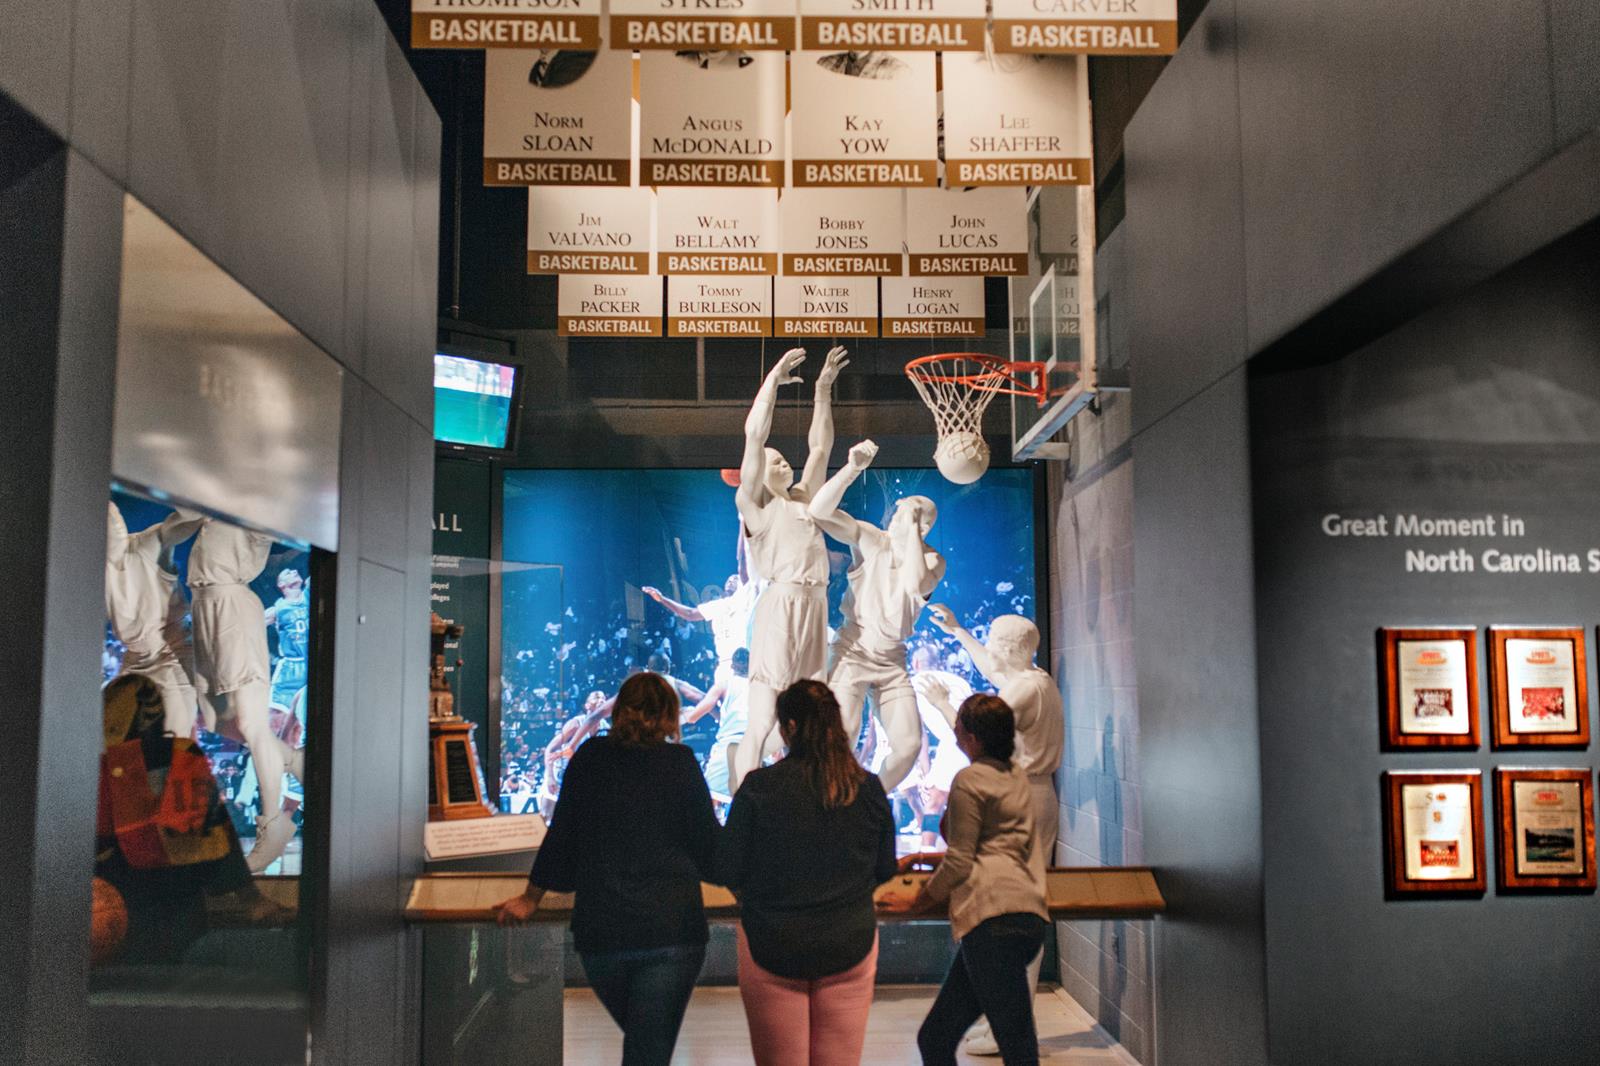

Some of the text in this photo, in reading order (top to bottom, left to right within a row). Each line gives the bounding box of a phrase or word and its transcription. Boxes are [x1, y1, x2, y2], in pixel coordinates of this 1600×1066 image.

[429, 19, 581, 43] BASKETBALL
[627, 21, 778, 44] BASKETBALL
[818, 22, 968, 46] BASKETBALL
[1011, 25, 1160, 48] BASKETBALL
[522, 135, 594, 152] SLOAN
[840, 138, 890, 154] YOW
[969, 136, 1061, 153] SHAFFER
[497, 163, 617, 182] BASKETBALL
[652, 164, 772, 183] BASKETBALL
[805, 164, 924, 183] BASKETBALL
[959, 163, 1077, 182] BASKETBALL
[548, 232, 632, 247] VALVANO
[675, 234, 760, 249] BELLAMY
[815, 234, 869, 249] JONES
[939, 234, 998, 248] LUCAS
[539, 255, 638, 271] BASKETBALL
[668, 255, 767, 271] BASKETBALL
[793, 257, 891, 273] BASKETBALL
[920, 257, 1017, 273] BASKETBALL
[581, 301, 641, 314] PACKER
[679, 301, 761, 314] BURLESON
[804, 302, 849, 314] DAVIS
[907, 302, 960, 315] LOGAN
[568, 319, 652, 334] BASKETBALL
[678, 319, 762, 334] BASKETBALL
[784, 320, 868, 335] BASKETBALL
[892, 321, 976, 336] BASKETBALL
[1321, 514, 1525, 537] Great Moment in
[1405, 548, 1475, 573] North
[1481, 547, 1582, 573] Carolina
